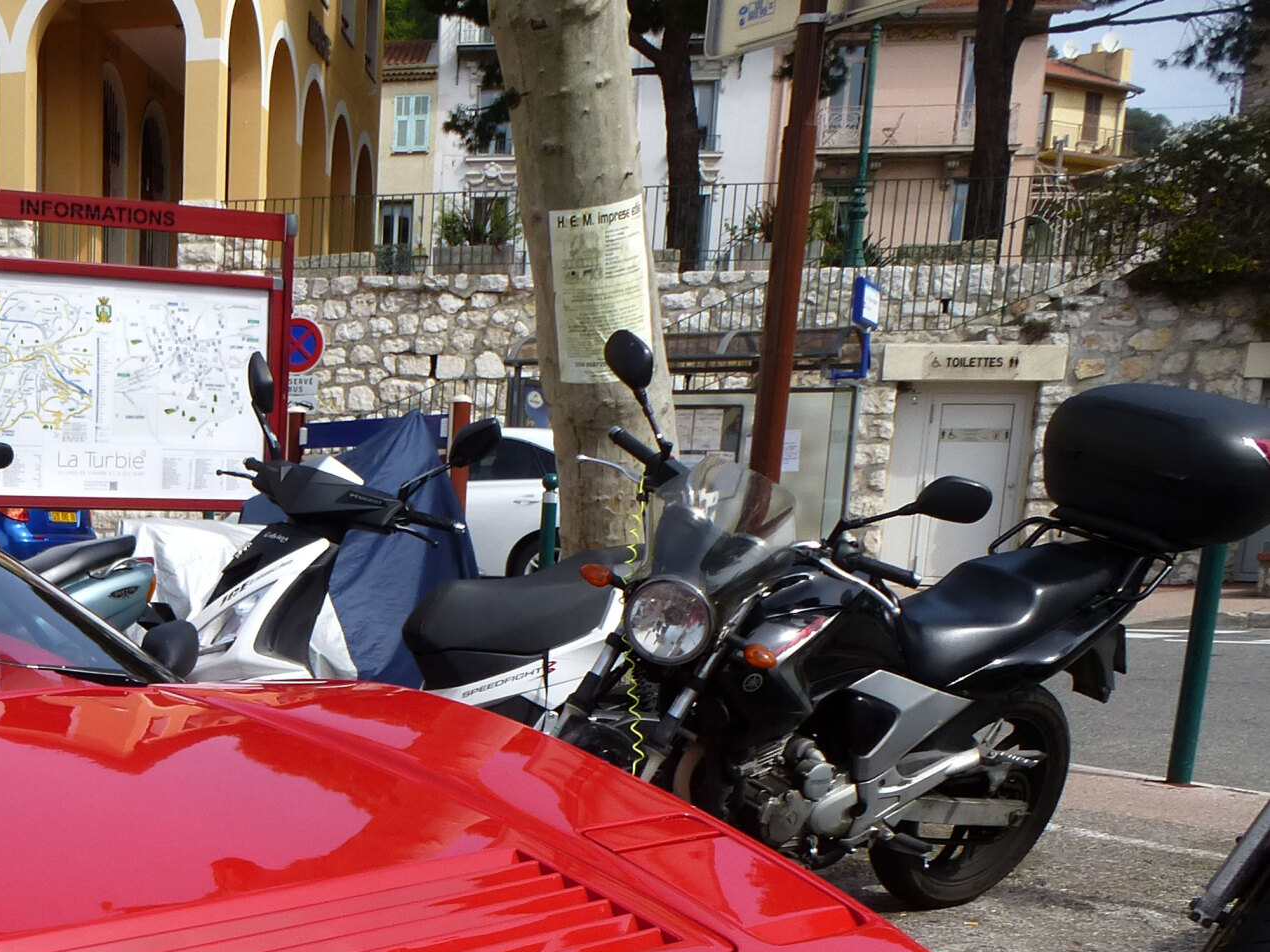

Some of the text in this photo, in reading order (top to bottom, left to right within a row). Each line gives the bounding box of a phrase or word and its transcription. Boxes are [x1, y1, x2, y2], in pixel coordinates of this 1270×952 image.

[20, 198, 176, 227] INFORMATIONS
[597, 207, 630, 225] imprese
[945, 356, 1004, 368] TOILETTES
[57, 450, 145, 469] La Turbie
[461, 666, 542, 698] SPEEDFIGHT
